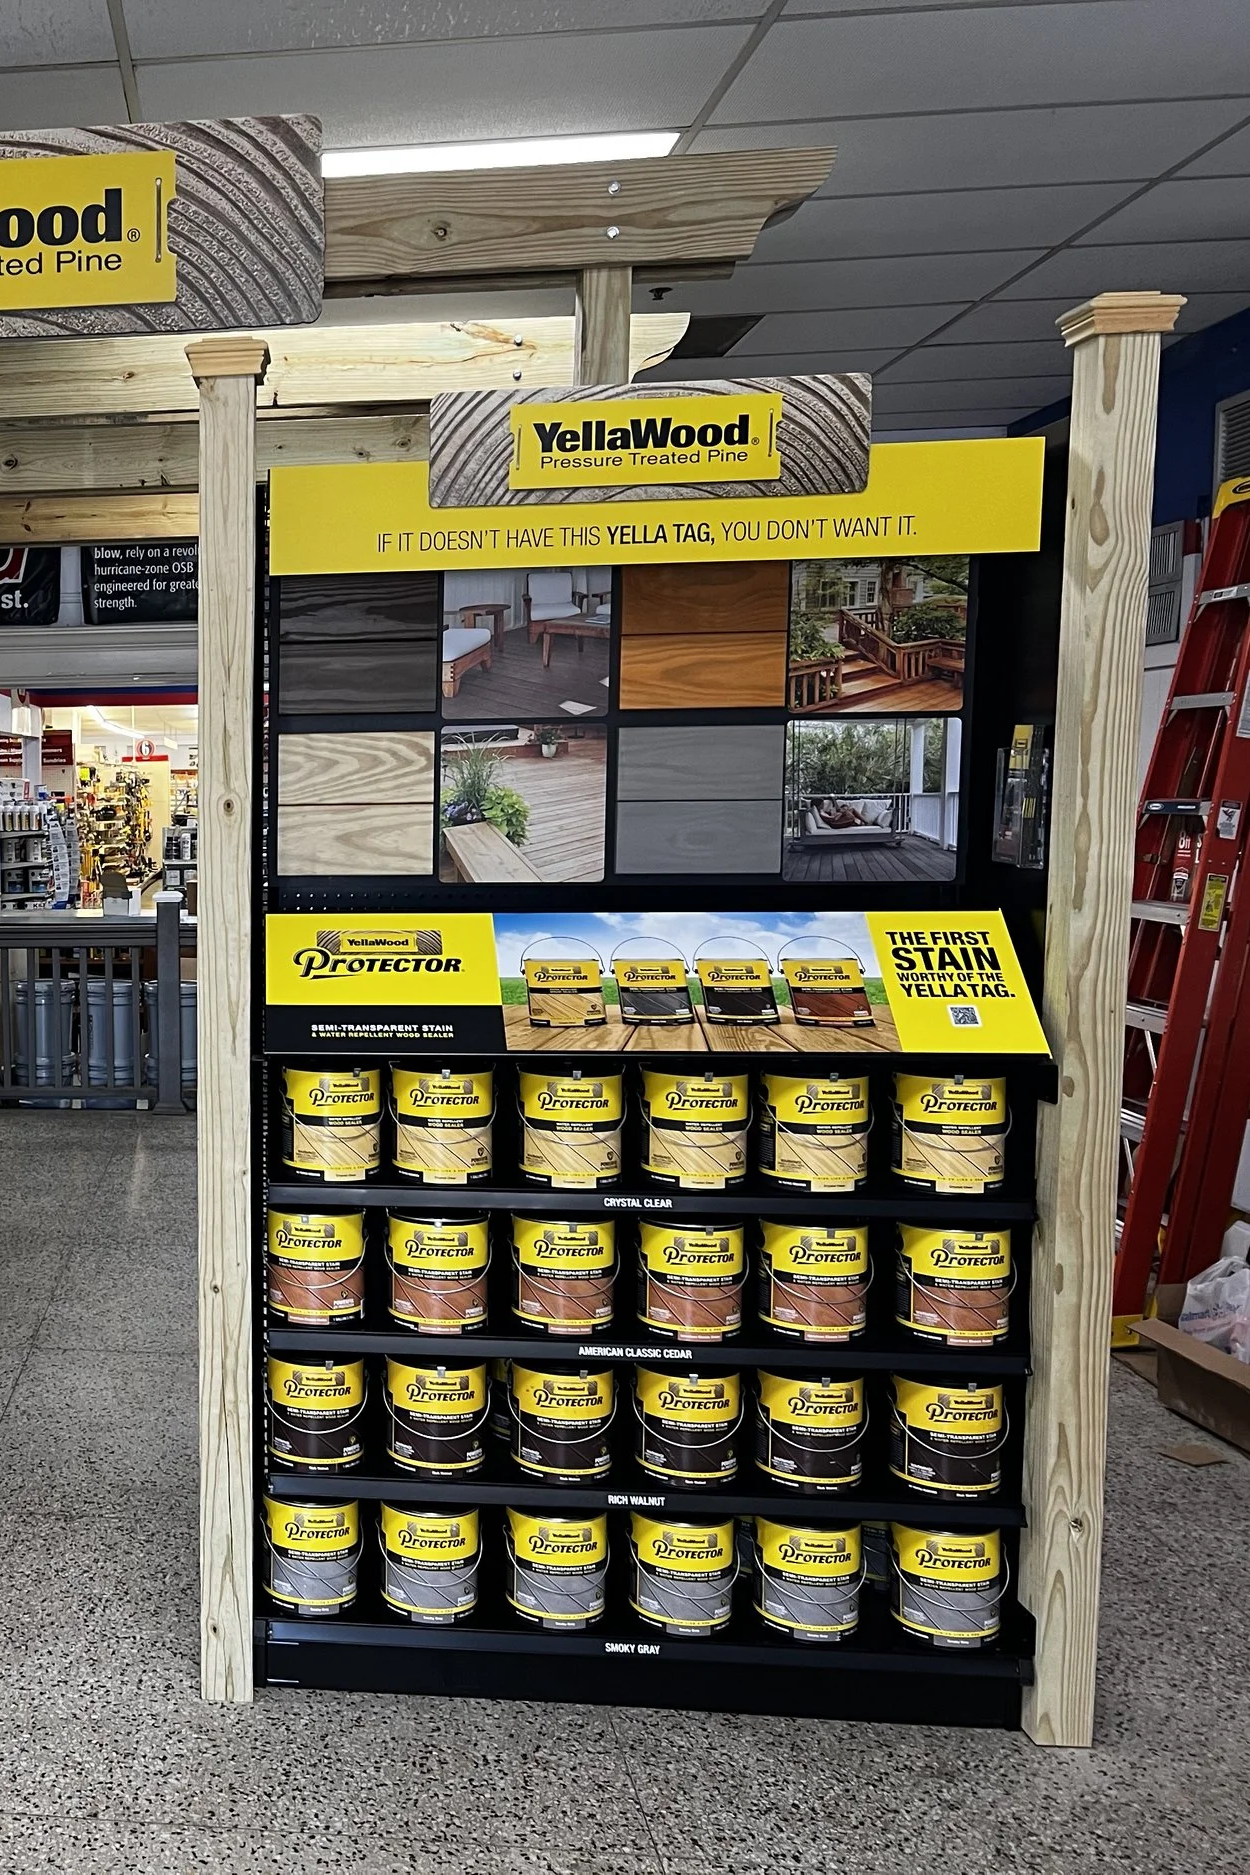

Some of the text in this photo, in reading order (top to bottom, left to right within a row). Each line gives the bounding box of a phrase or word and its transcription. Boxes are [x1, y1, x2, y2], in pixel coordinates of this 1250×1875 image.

[57, 250, 122, 273] Pine
[533, 414, 749, 454] YellaWood
[541, 449, 748, 469] Pressure Treated Pine
[378, 515, 916, 552] IF IT DOESN'T HAVE THIS YELLA TAG, YOU DON'T WANT IT.
[94, 545, 199, 561] blow, rely on a revol
[94, 563, 194, 575] hurricane-zone OSB
[94, 578, 199, 592] engineered for greate
[94, 597, 138, 609] strength.
[141, 741, 150, 757] 6
[885, 931, 990, 945] THE FIRST
[892, 947, 1001, 971] STAIN
[896, 972, 1005, 982] WORTHY OF THE
[900, 983, 1016, 998] YELLA TAG.
[311, 1024, 418, 1032] SEMI-TRANSPARENT
[604, 1198, 672, 1208] CRYSTAL CLEAR
[578, 1346, 692, 1359] AMERICAN CLASSIC CEDAR
[608, 1495, 665, 1506] RICH WALNUT
[605, 1643, 660, 1655] SMOKY GRAY
